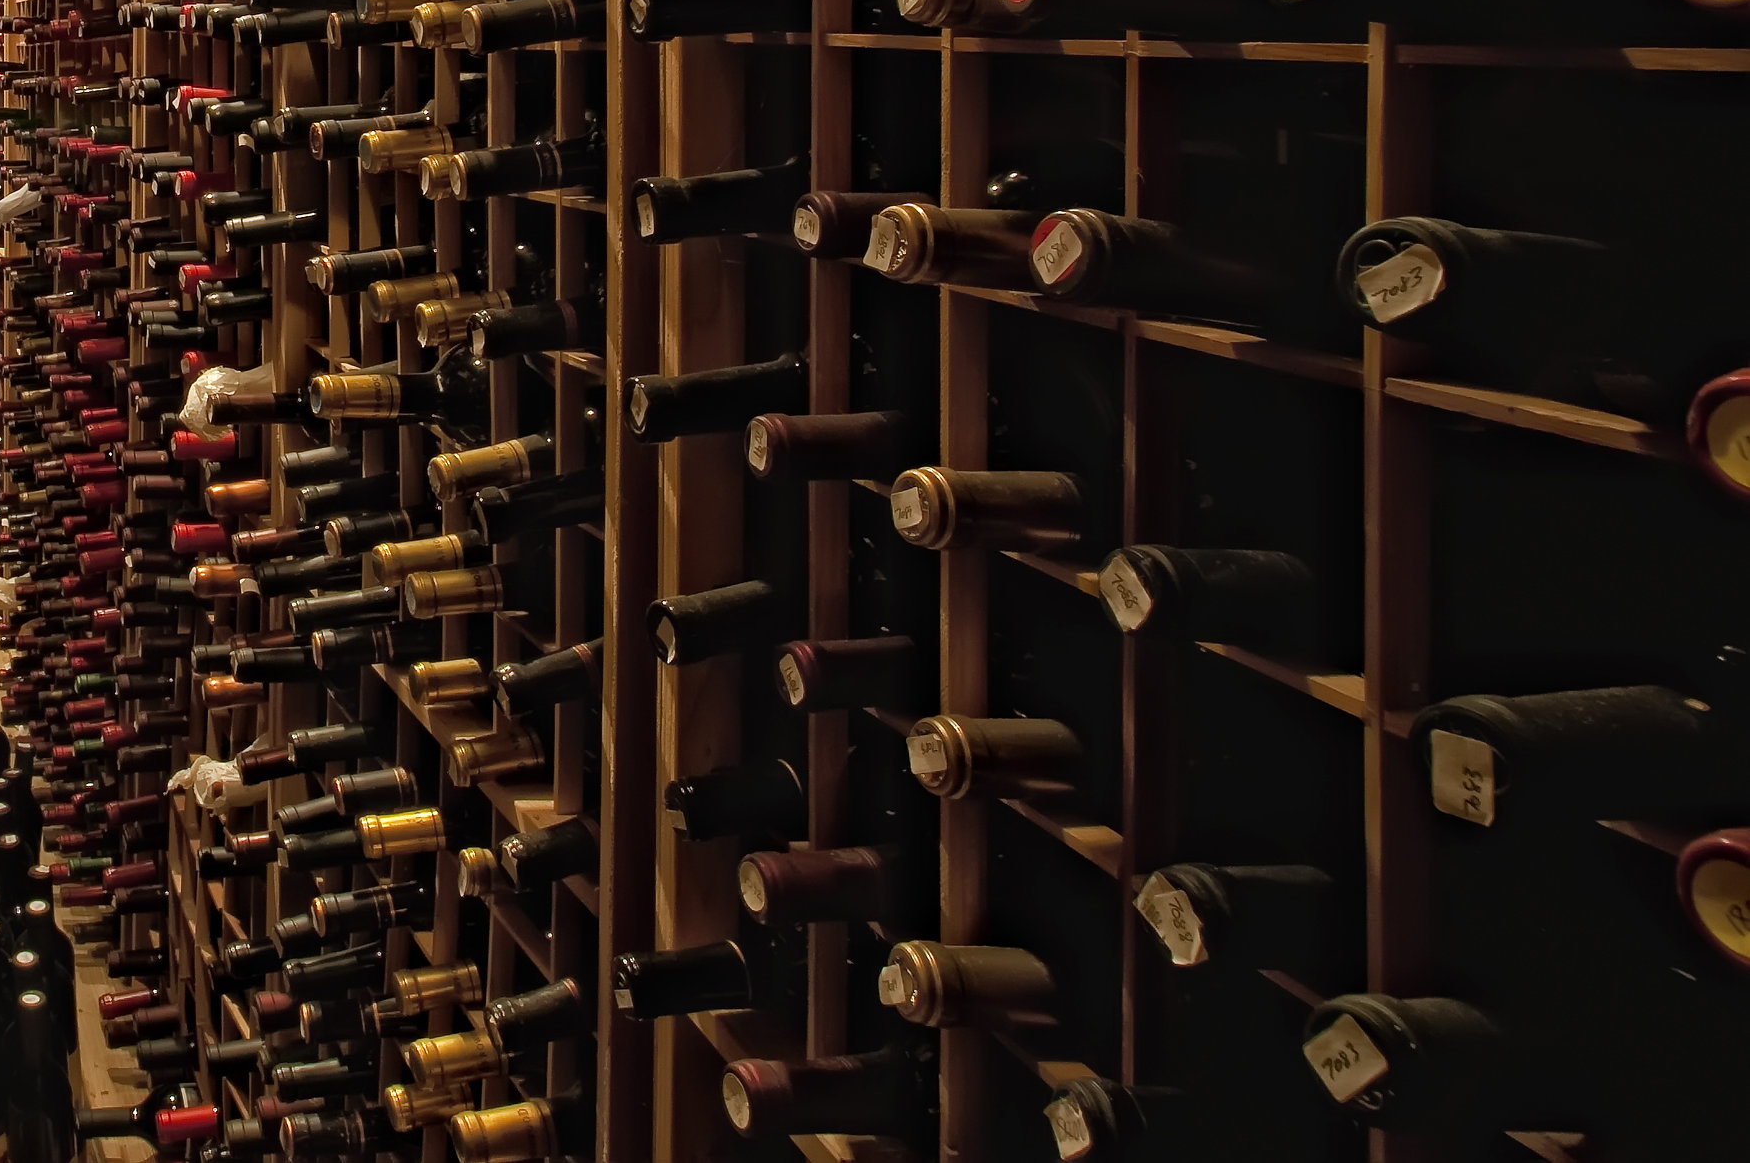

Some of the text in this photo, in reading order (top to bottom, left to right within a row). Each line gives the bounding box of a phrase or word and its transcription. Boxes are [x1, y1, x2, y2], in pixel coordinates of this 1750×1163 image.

[1038, 231, 1070, 273] 7086
[1371, 266, 1423, 303] 7083
[1168, 896, 1193, 944] 7088
